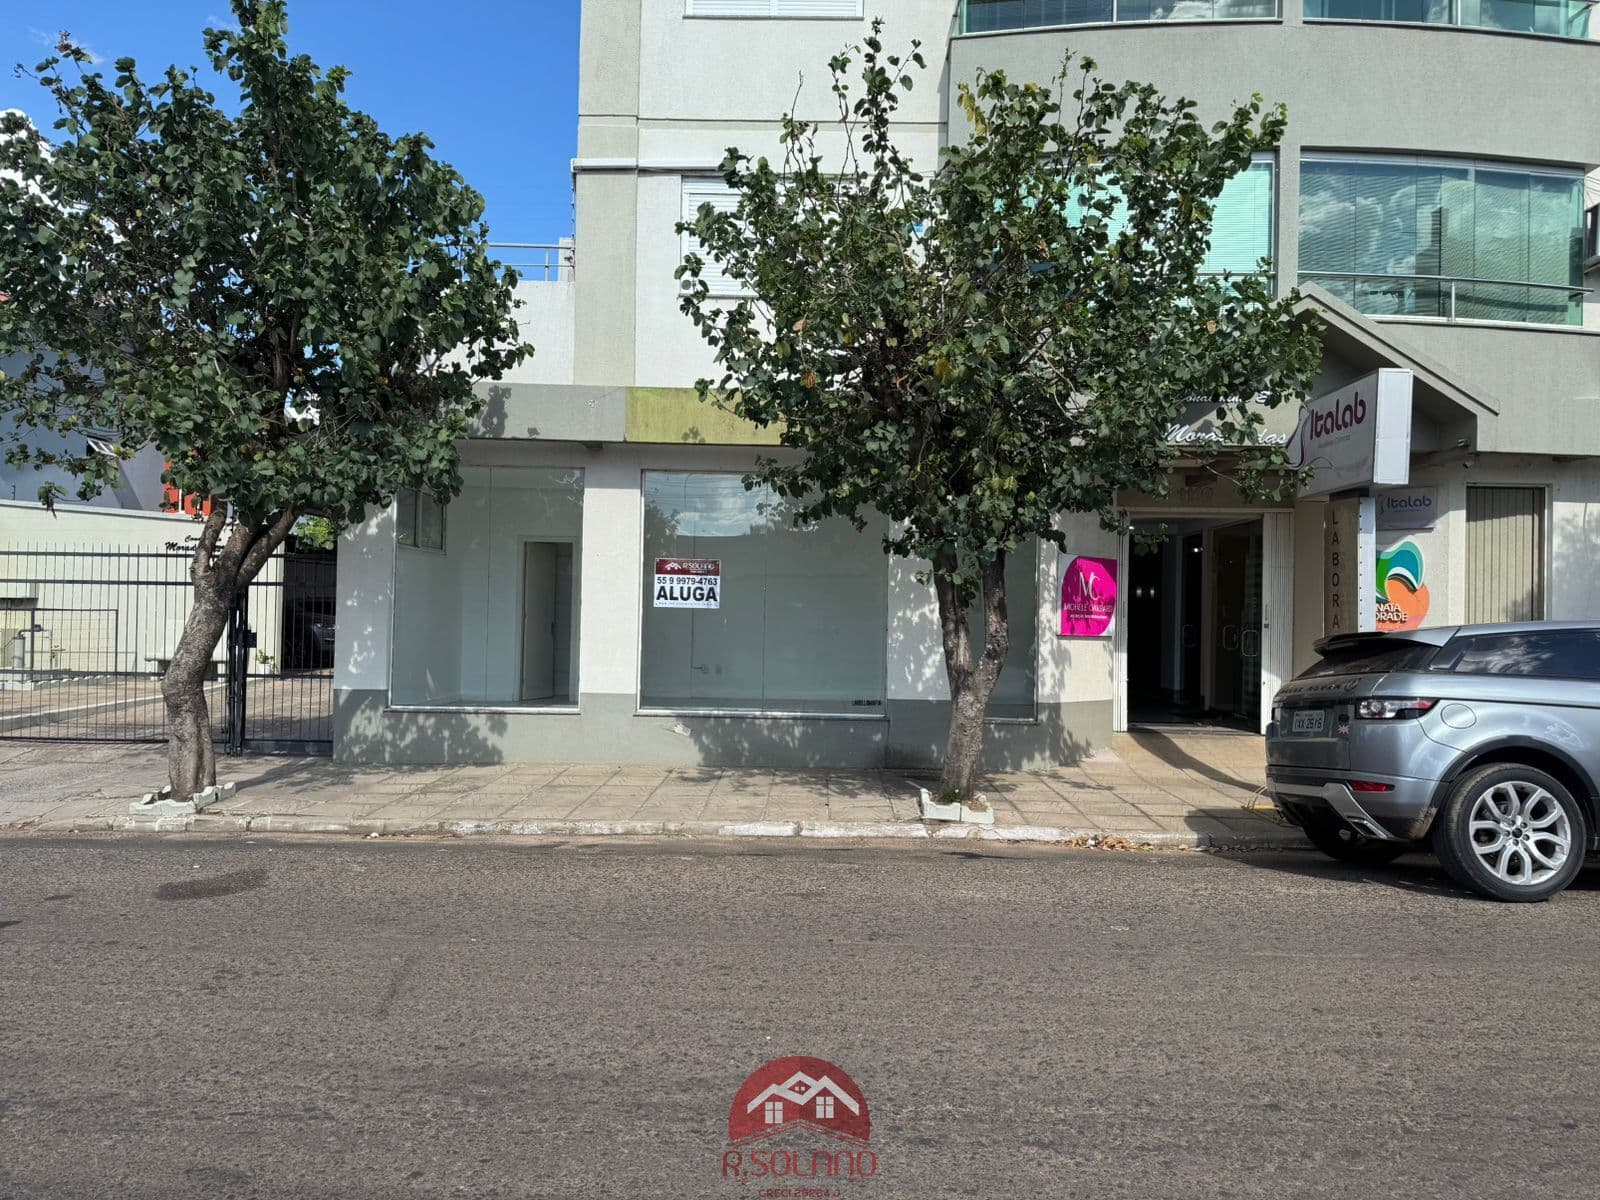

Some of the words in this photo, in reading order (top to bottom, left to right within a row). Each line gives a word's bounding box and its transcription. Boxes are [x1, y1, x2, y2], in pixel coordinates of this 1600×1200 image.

[1310, 392, 1367, 440] Italab
[1387, 495, 1432, 508] Italab
[657, 576, 668, 584] 55
[676, 577, 718, 586] 9979-4763
[656, 586, 718, 602] ALUGA
[1376, 603, 1401, 612] NATA
